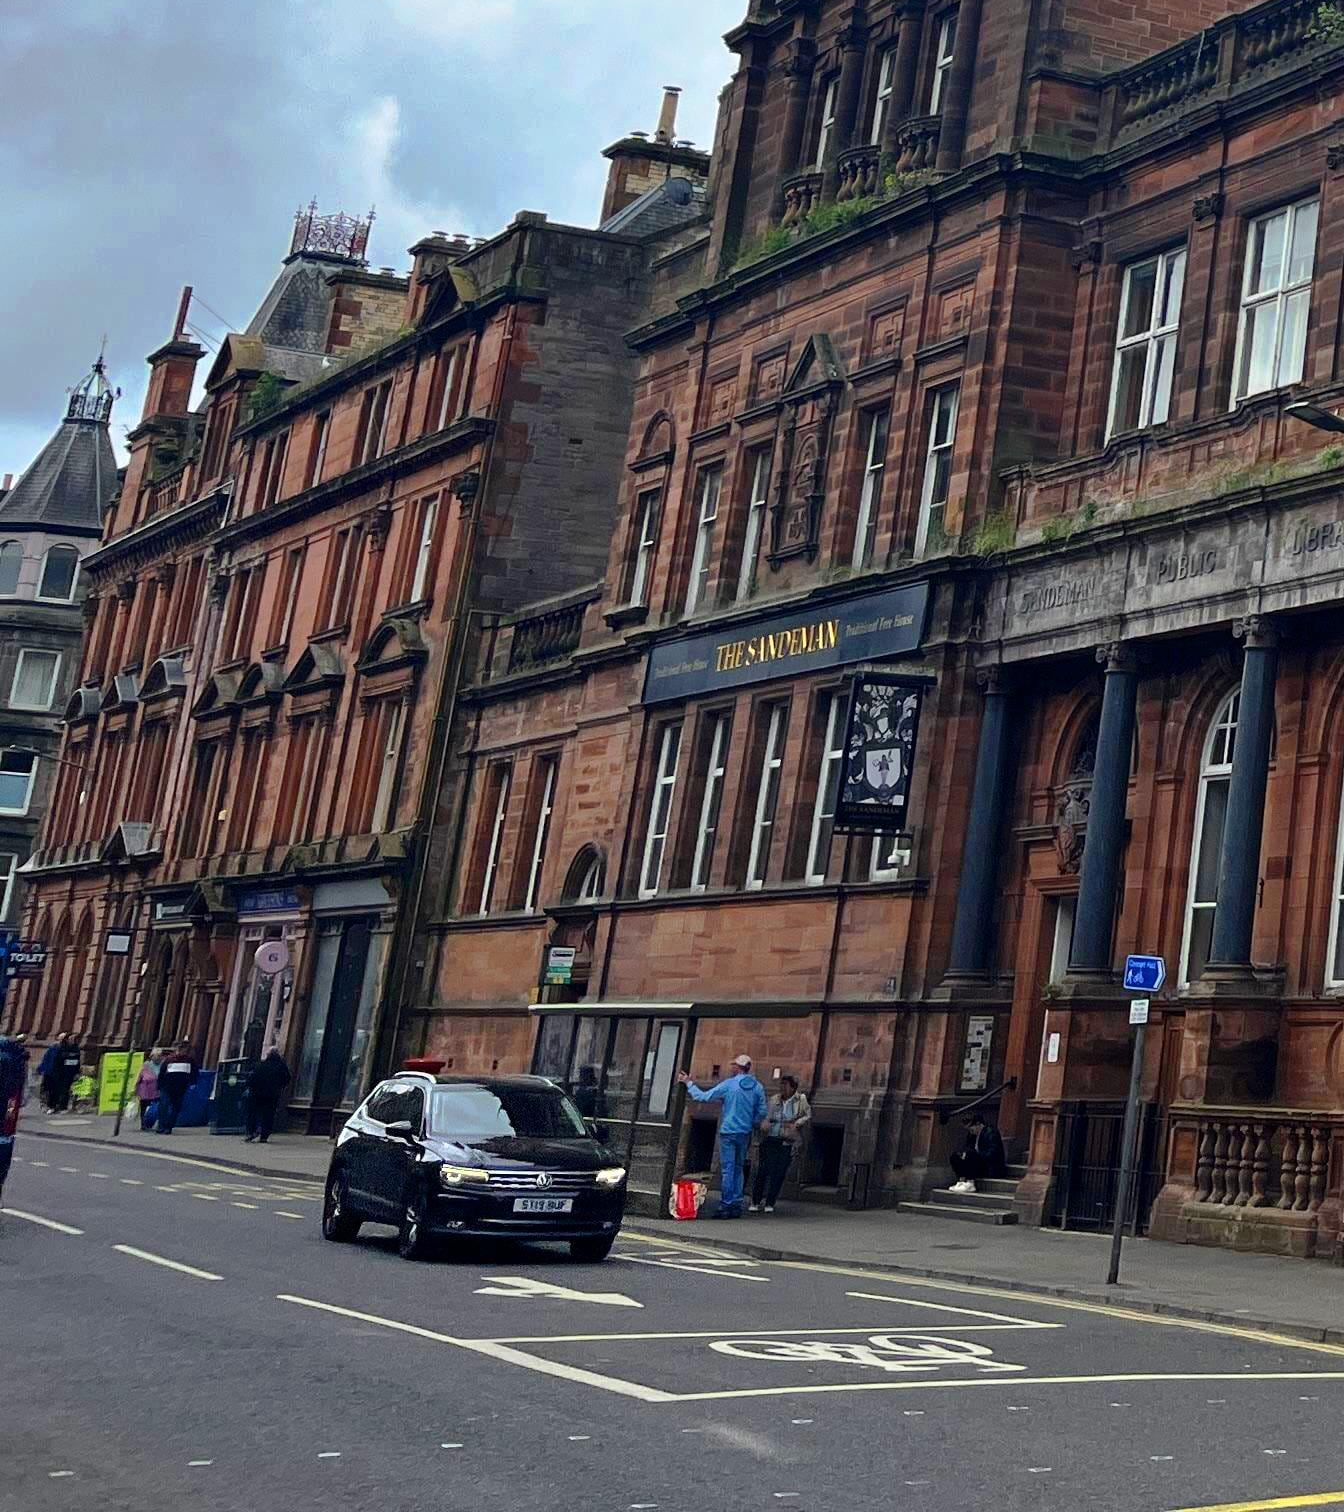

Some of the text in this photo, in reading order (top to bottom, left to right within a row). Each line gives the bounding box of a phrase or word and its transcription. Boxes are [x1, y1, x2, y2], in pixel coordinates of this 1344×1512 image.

[1157, 551, 1217, 585] PUBLIC
[716, 641, 745, 672] THE
[745, 619, 840, 666] SANDEMAN
